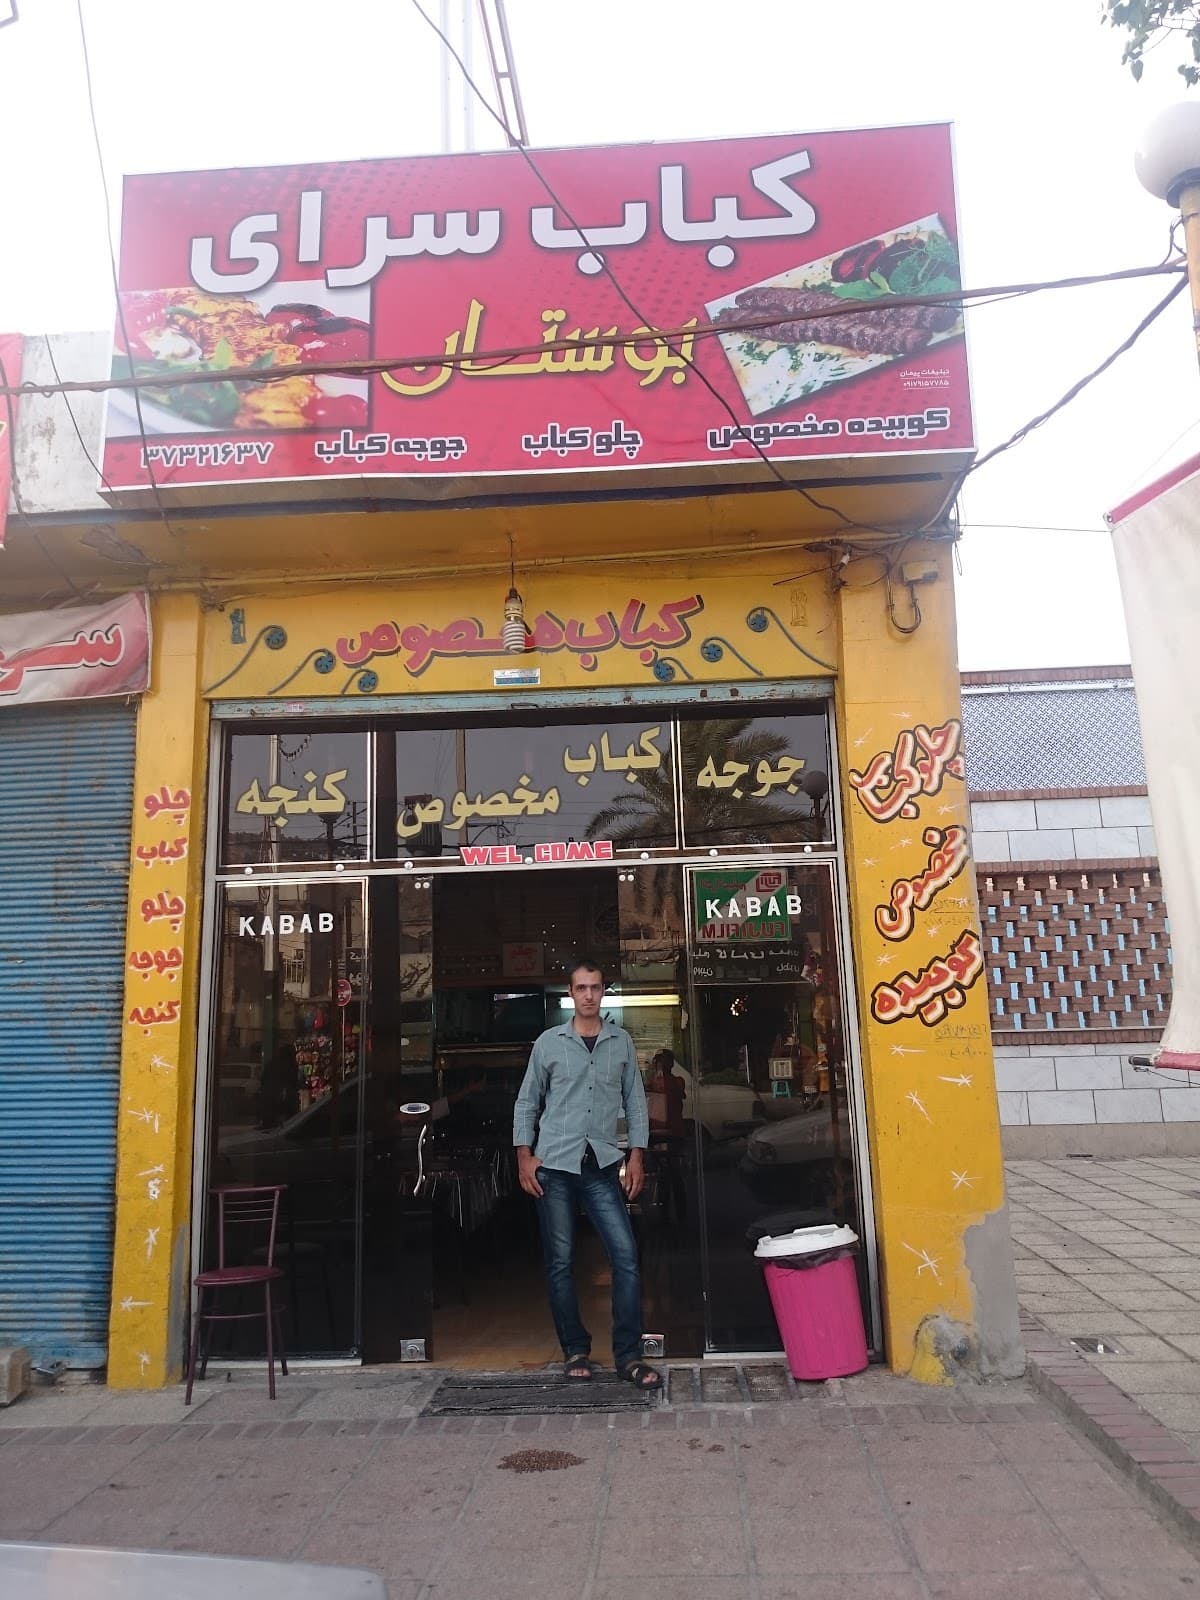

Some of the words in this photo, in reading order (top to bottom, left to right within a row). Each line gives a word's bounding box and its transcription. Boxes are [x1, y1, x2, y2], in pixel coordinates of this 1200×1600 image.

[530, 150, 817, 275] کباب
[189, 190, 501, 294] سرای
[380, 298, 698, 396] بوستان
[523, 422, 591, 458] کباب
[594, 420, 641, 459] چلو
[706, 412, 842, 451] مخصوص
[846, 407, 951, 440] کوبیده
[314, 430, 390, 464] کباب
[392, 435, 467, 462] جوجه
[562, 594, 704, 672] کباب
[563, 725, 662, 788] کباب
[696, 752, 805, 800] جوجه
[143, 785, 192, 826] چلو
[235, 768, 348, 829] کنجه
[396, 773, 561, 838] مخصوص
[136, 837, 188, 868] کباب
[874, 824, 969, 942] مخصوص
[140, 892, 186, 934] چلو
[238, 912, 335, 937] KABAB
[705, 894, 802, 919] KABAB
[128, 946, 184, 983] جوجه
[870, 928, 984, 1028] کوبیده
